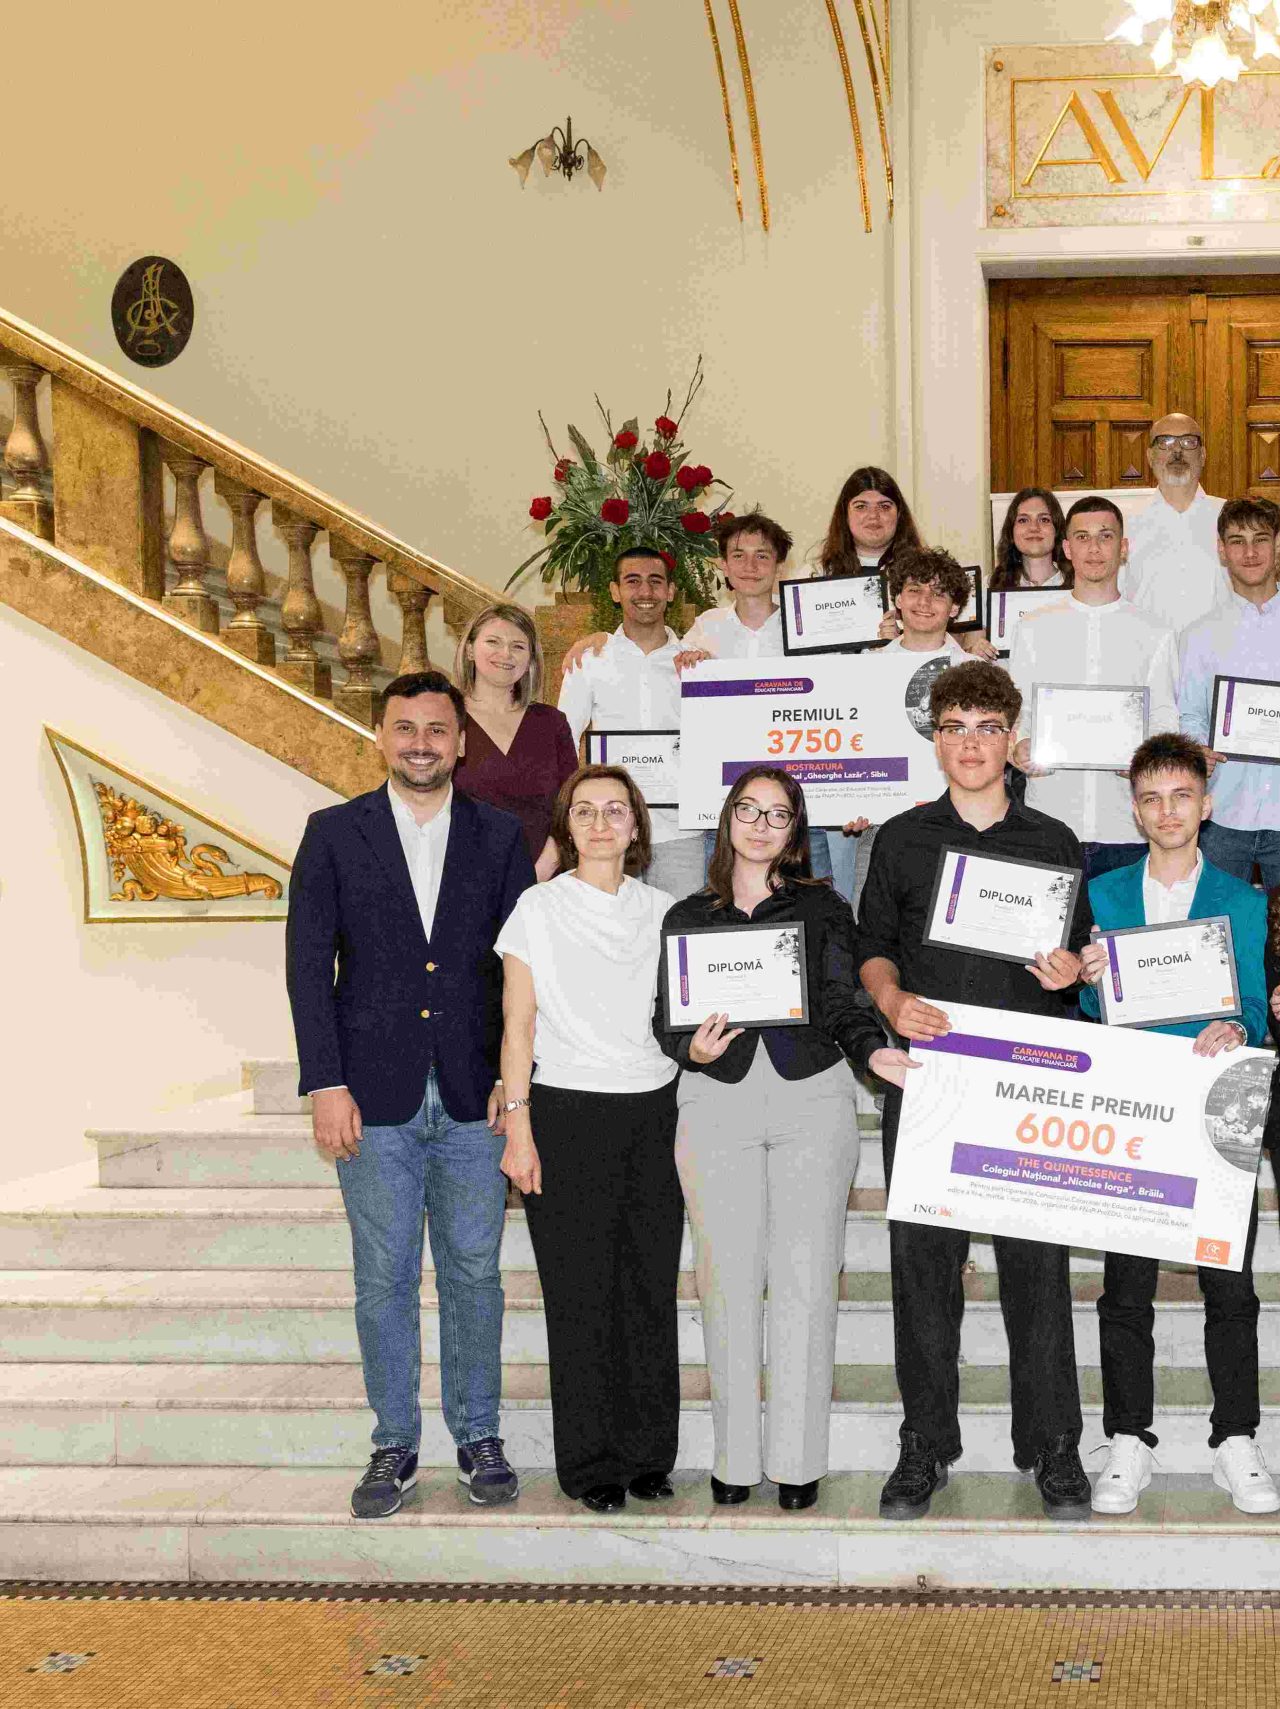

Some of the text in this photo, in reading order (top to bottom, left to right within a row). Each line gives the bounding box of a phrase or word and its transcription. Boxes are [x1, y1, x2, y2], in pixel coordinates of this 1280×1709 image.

[815, 598, 857, 611] DIPLOMĂ
[772, 708, 858, 722] PREMIUL 2
[767, 729, 864, 754] 3750 €
[622, 754, 664, 764] DIPLOMĂ
[786, 763, 844, 771] BOSTRATURA
[979, 888, 1033, 908] DIPLOMĂ
[708, 958, 763, 973] DIPLOMĂ
[1138, 951, 1192, 968] DIPLOMĂ
[1012, 1054, 1078, 1069] EDUCAȚIE FINANCIARĂ
[1013, 1047, 1078, 1062] CARAVANA DE
[995, 1081, 1175, 1123] MARELE PREMIU
[1016, 1113, 1144, 1160] 6000 €
[1017, 1157, 1133, 1183] THE QUINTESSENCE
[982, 1164, 1020, 1177] Colegiul
[1138, 1187, 1165, 1199] Brăila
[914, 1204, 936, 1215] ING
